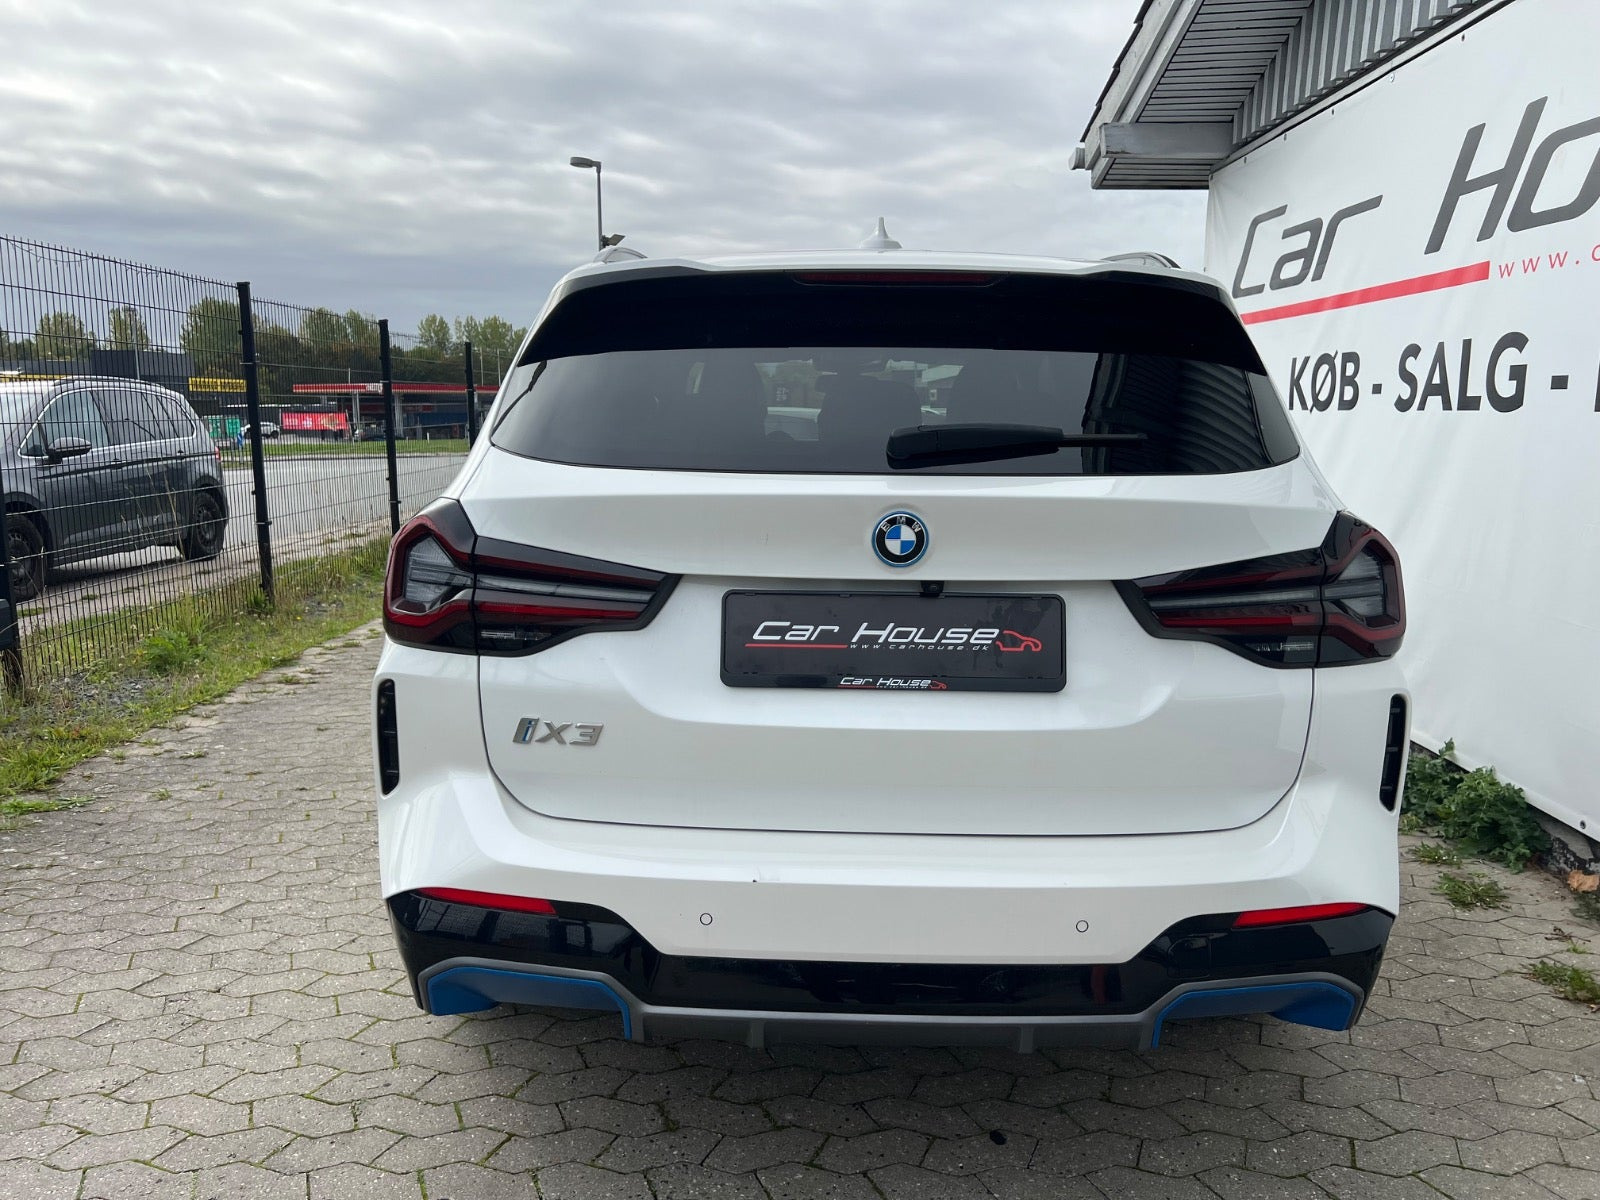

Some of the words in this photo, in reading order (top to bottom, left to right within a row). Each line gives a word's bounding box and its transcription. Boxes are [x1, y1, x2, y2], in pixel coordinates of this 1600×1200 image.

[1232, 194, 1383, 299] Car
[1424, 96, 1600, 255] Ho
[1288, 350, 1360, 414] KØB
[1394, 331, 1530, 413] SALG
[880, 516, 922, 533] BMW
[753, 621, 840, 641] Car
[851, 622, 1000, 644] House
[840, 677, 873, 686] Car
[876, 677, 932, 687] House
[513, 715, 604, 746] iX3
